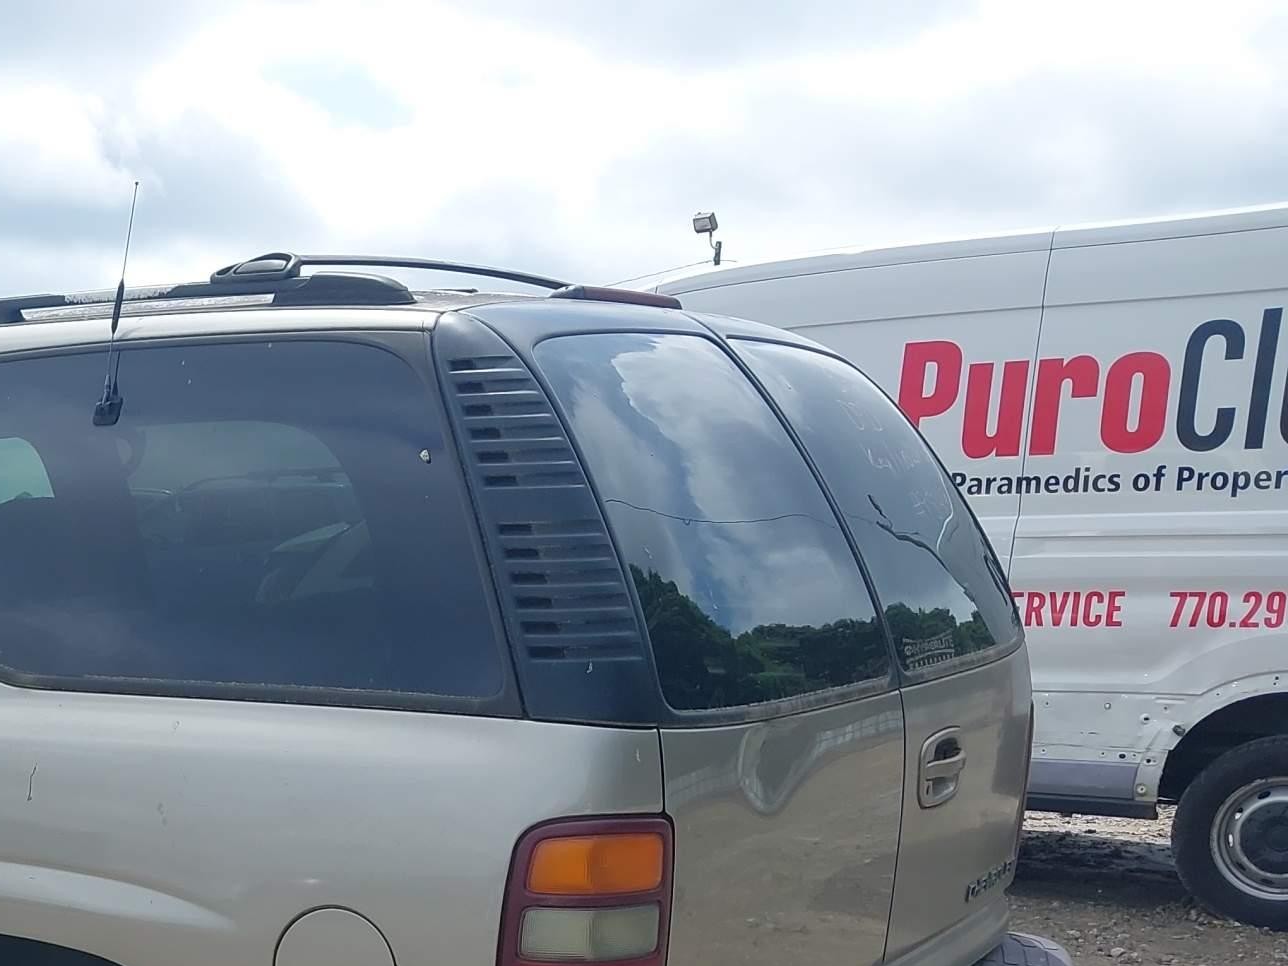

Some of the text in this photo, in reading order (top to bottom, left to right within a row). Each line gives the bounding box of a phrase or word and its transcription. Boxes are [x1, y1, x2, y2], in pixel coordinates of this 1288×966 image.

[898, 307, 1288, 459] PuroCl
[951, 465, 1288, 498] Paramedics of Proper
[1169, 591, 1287, 628] 770.29
